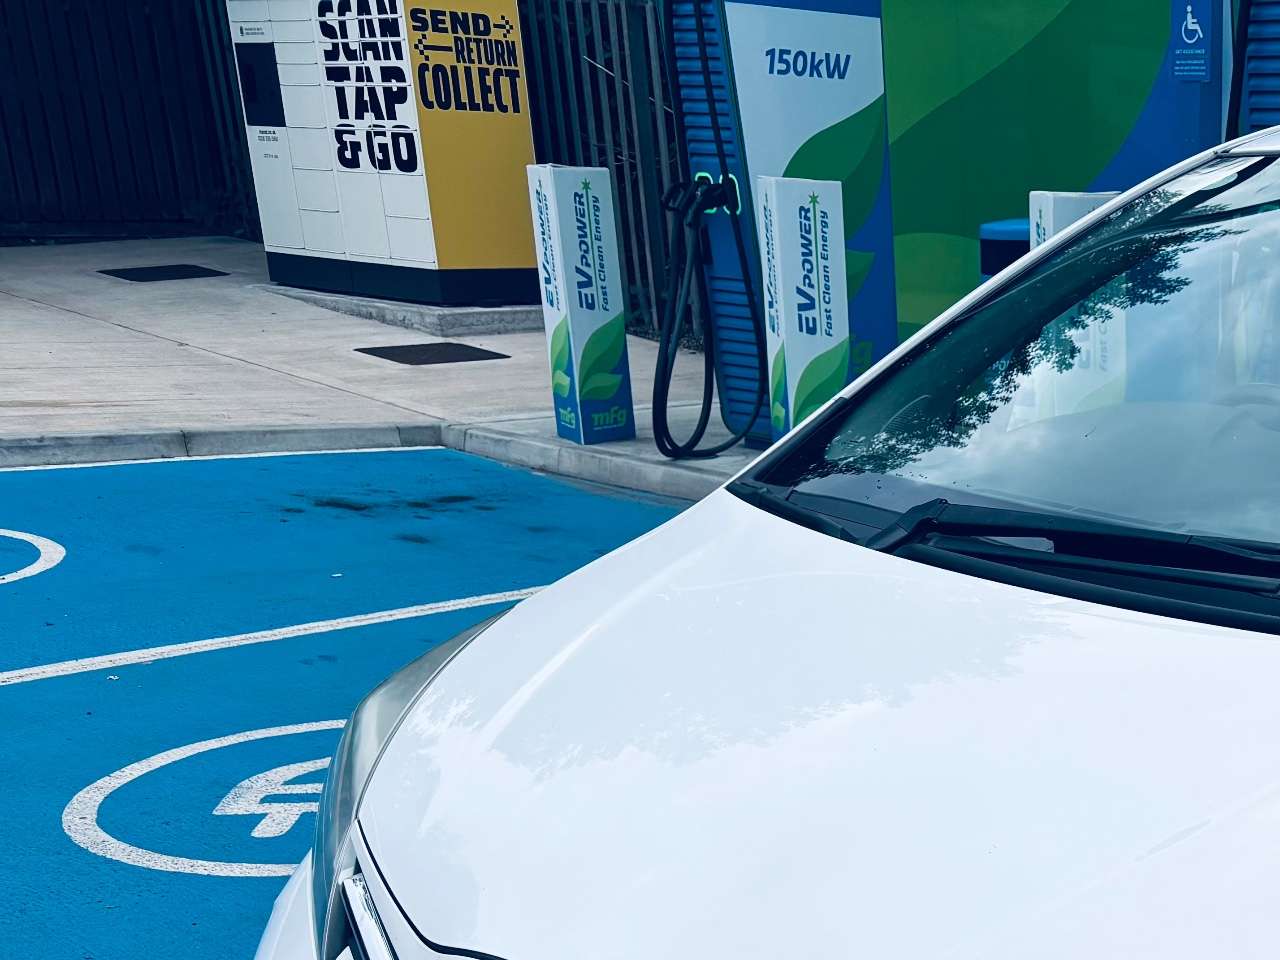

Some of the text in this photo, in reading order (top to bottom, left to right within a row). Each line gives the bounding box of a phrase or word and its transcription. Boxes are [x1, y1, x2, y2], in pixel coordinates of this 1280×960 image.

[317, 0, 404, 61] SCAN
[410, 8, 492, 37] SEND
[453, 35, 518, 67] RETURN
[765, 47, 851, 80] 150kW
[325, 65, 408, 120] TAP
[418, 63, 521, 114] COLLECT
[592, 195, 610, 312] Fast Clean Energy
[820, 210, 833, 337] Fast Clean Energy
[591, 406, 627, 427] mfg
